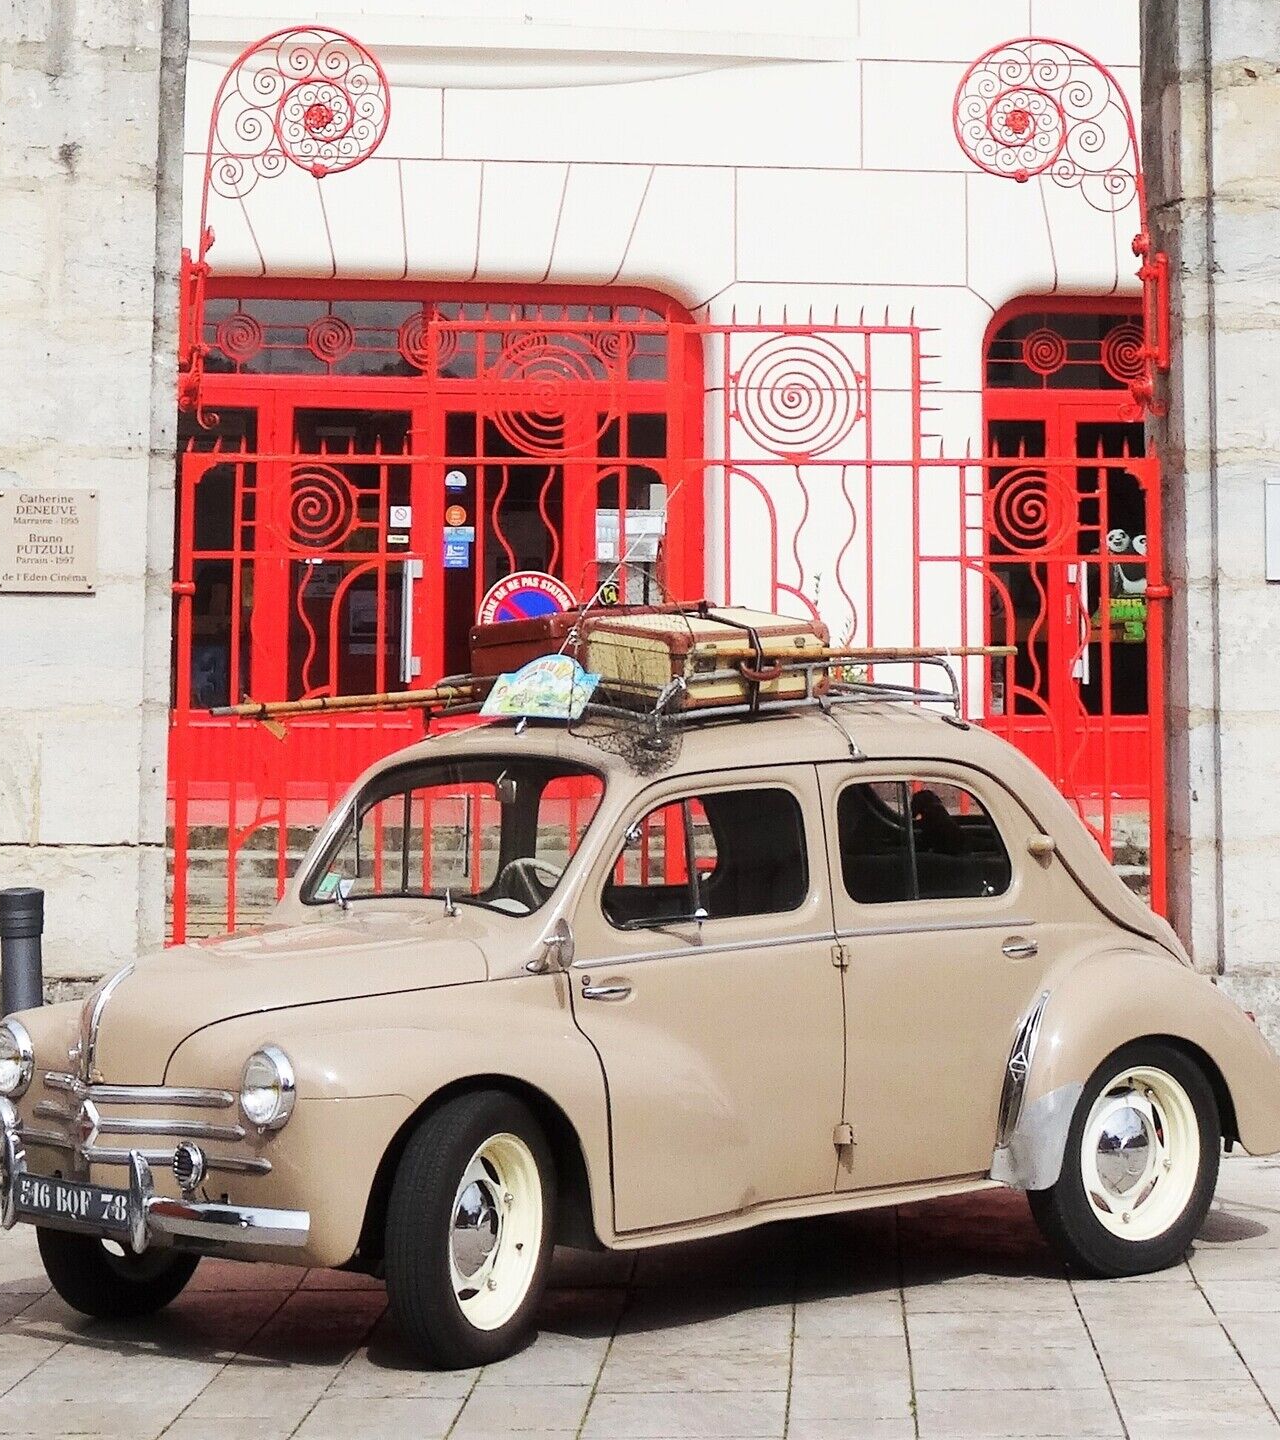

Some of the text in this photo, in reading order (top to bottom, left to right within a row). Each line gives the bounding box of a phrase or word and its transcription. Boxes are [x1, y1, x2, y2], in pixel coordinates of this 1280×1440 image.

[19, 493, 74, 504] Catherine
[16, 505, 77, 516] DENEUVE
[28, 533, 63, 543] Bruno
[16, 545, 74, 555] PUTZULU
[56, 1186, 92, 1219] BQF
[100, 1193, 127, 1221] 78
